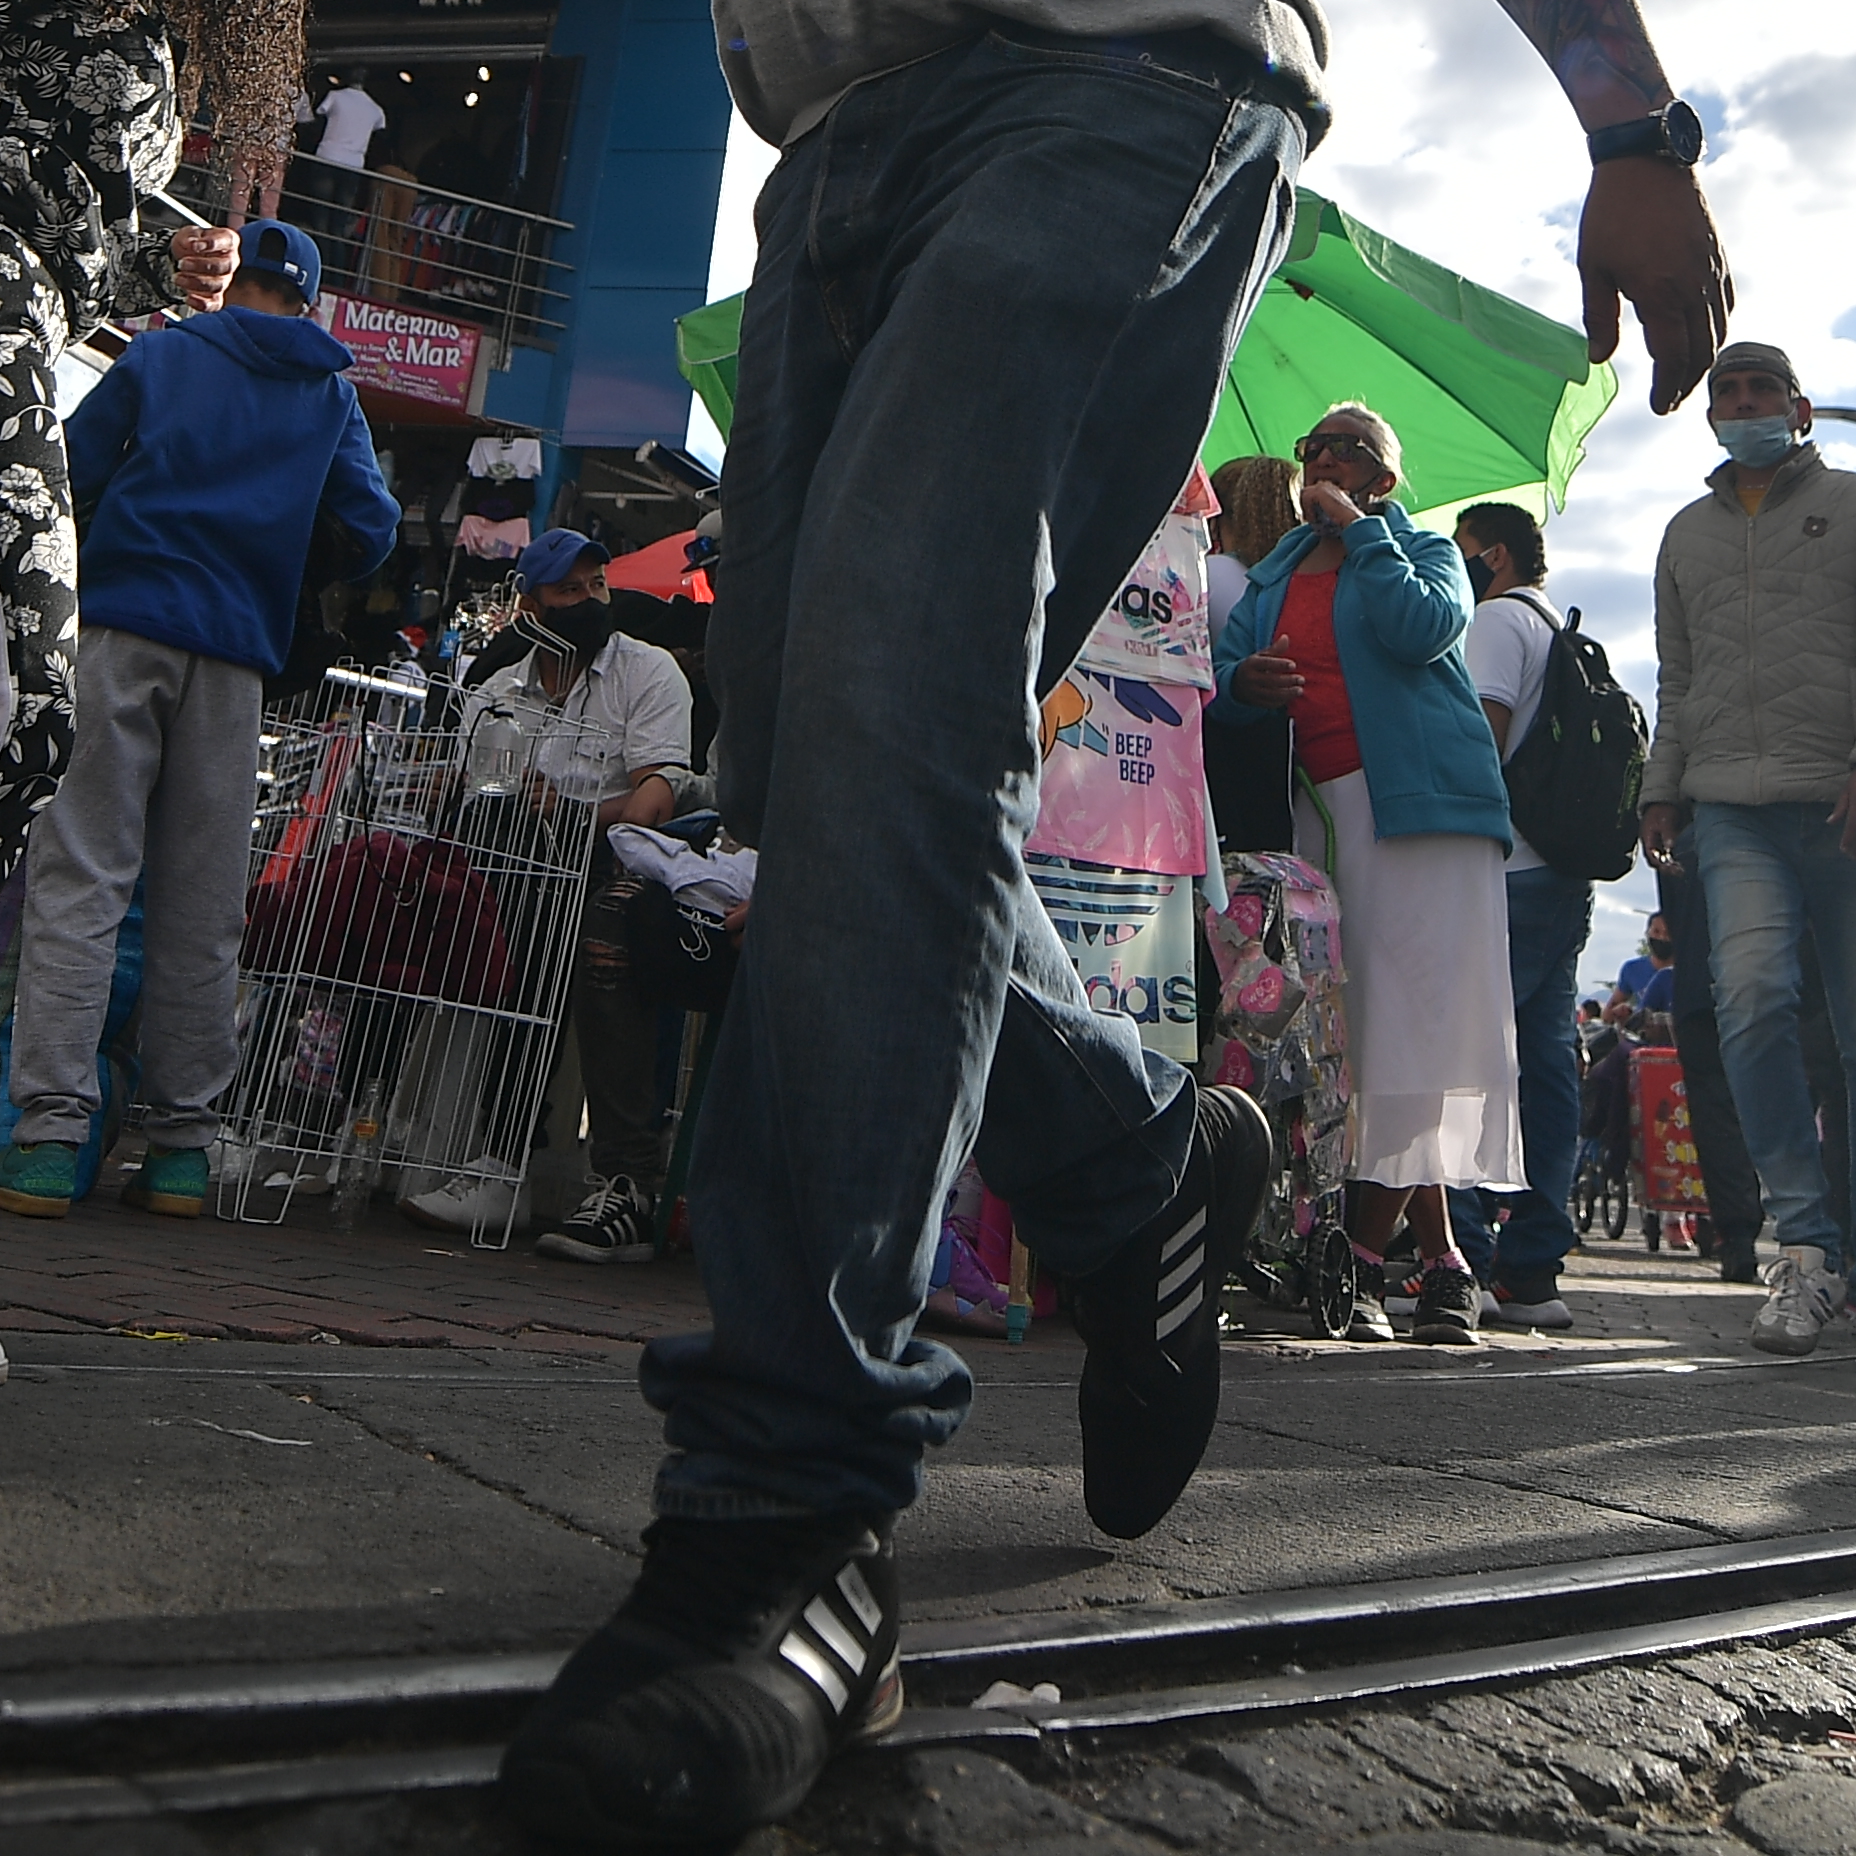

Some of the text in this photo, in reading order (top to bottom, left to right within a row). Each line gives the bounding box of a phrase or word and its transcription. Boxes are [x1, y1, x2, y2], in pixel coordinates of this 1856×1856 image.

[385, 336, 403, 362] &
[1115, 732, 1152, 758] BEEP
[1119, 759, 1155, 786] BEEP
[1072, 957, 1197, 1024] das
